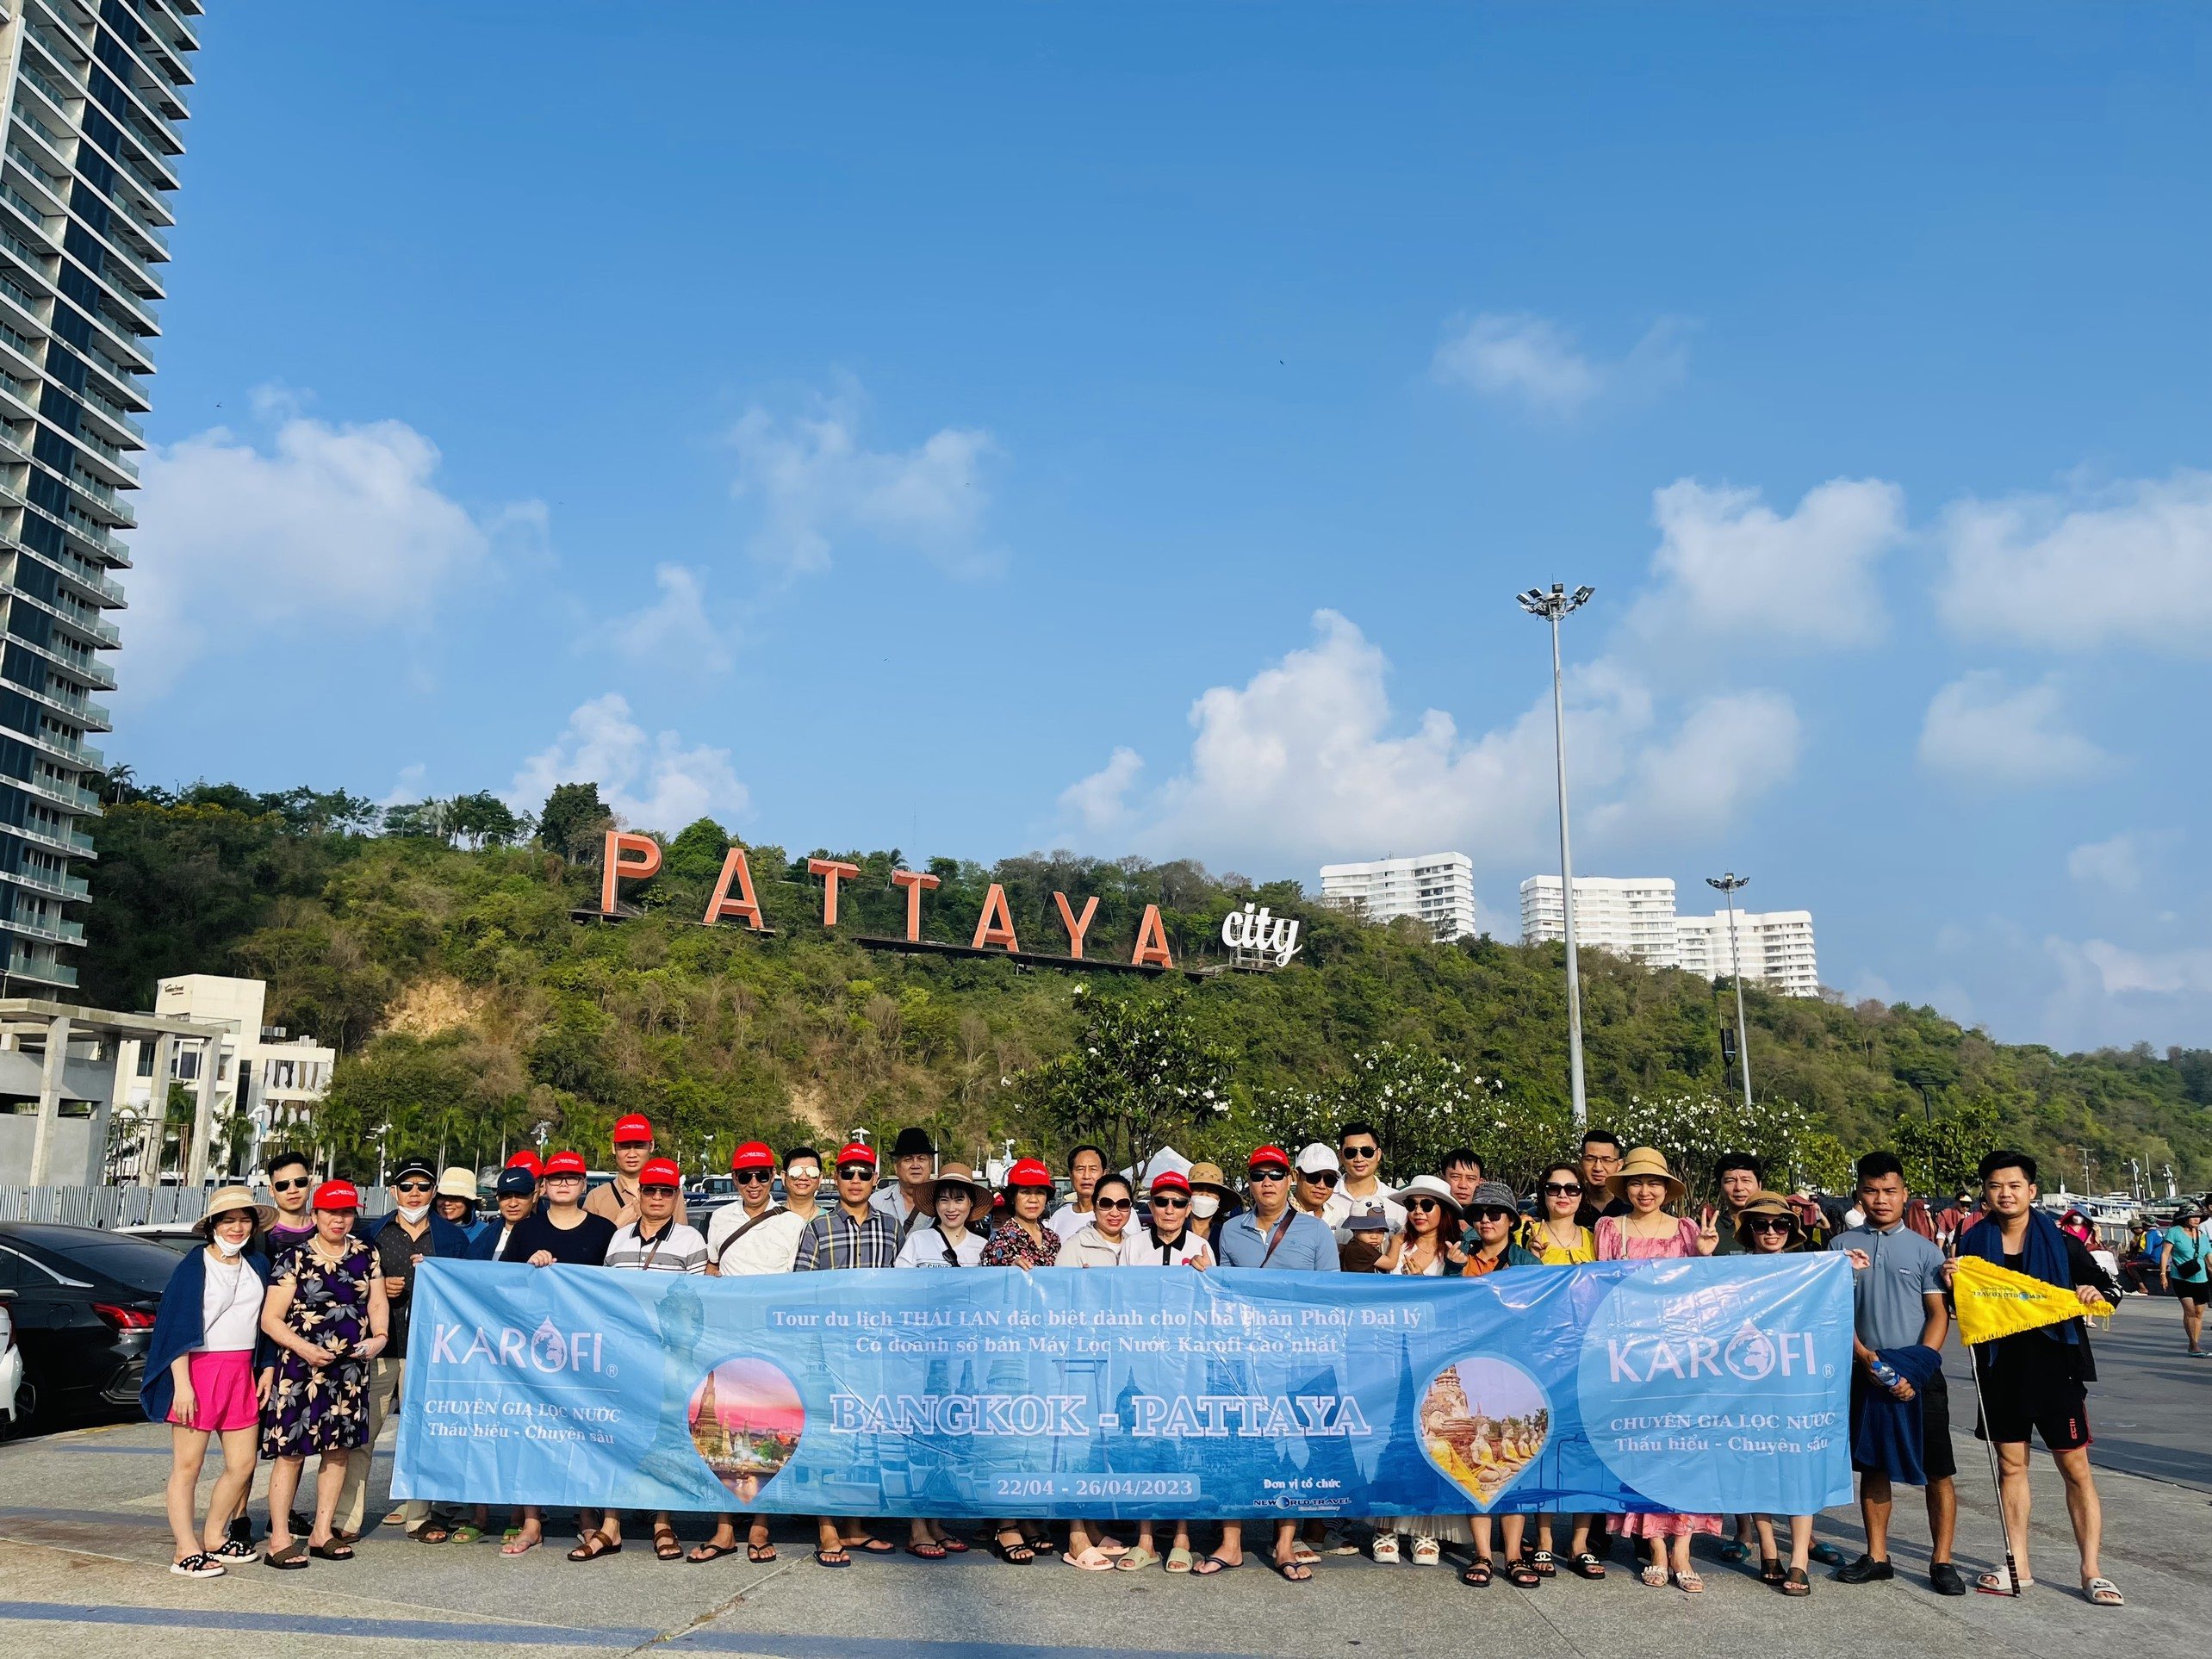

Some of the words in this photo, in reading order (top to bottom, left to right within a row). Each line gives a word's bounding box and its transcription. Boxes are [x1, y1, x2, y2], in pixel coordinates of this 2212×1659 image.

[600, 830, 1174, 969] PATTAYA
[1221, 902, 1302, 967] city
[773, 1311, 819, 1326] Tour
[824, 1310, 849, 1326] du
[856, 1310, 893, 1330] lịch
[899, 1307, 951, 1326] THÁI
[959, 1310, 1001, 1326] LAN
[1007, 1309, 1041, 1329] đặc
[1047, 1309, 1088, 1329] biệt
[1093, 1309, 1144, 1326] dành
[1150, 1309, 1186, 1326] cho
[1193, 1309, 1235, 1326] Nhà
[1241, 1308, 1294, 1326] Phân
[1361, 1308, 1397, 1329] Đại
[1402, 1308, 1421, 1328] lý
[432, 1314, 603, 1373] KAROFI
[855, 1336, 882, 1352] Có
[888, 1336, 949, 1352] doanh
[956, 1335, 979, 1352] số
[984, 1335, 1022, 1352] bán
[1028, 1335, 1070, 1356] Máy
[1076, 1336, 1110, 1357] Lọc
[1118, 1336, 1171, 1352] Nước
[1177, 1336, 1242, 1353] Karofi
[1249, 1339, 1284, 1352] cao
[1290, 1333, 1339, 1352] nhất
[1607, 1318, 1817, 1382] KAROFI
[425, 1398, 498, 1415] CHUYÊN
[502, 1401, 533, 1416] GIA
[538, 1404, 569, 1420] LỌC
[573, 1406, 621, 1422] NƯỚC
[829, 1394, 1090, 1437] BANGKOK
[1131, 1395, 1373, 1437] PATTAYA
[1610, 1412, 1692, 1432] CHUYÊN
[1698, 1414, 1733, 1429] GIA
[1738, 1414, 1780, 1432] LỌC
[1786, 1411, 1836, 1430] NƯỚC
[428, 1420, 468, 1437] Thấu
[473, 1421, 509, 1438] hiểu
[525, 1425, 586, 1442] Chuyên
[589, 1430, 615, 1444] sâu
[1615, 1435, 1662, 1451] Thấu
[1668, 1434, 1709, 1451] hiểu
[1728, 1436, 1802, 1456] Chuyên
[1806, 1436, 1829, 1452] sâu
[997, 1480, 1054, 1496] 22/04
[1076, 1480, 1193, 1496] 26/04/2023
[1264, 1478, 1285, 1488] Đơn
[1289, 1478, 1298, 1490] vị
[1315, 1478, 1341, 1488] chức
[1311, 1497, 1351, 1506] TRAVEL
